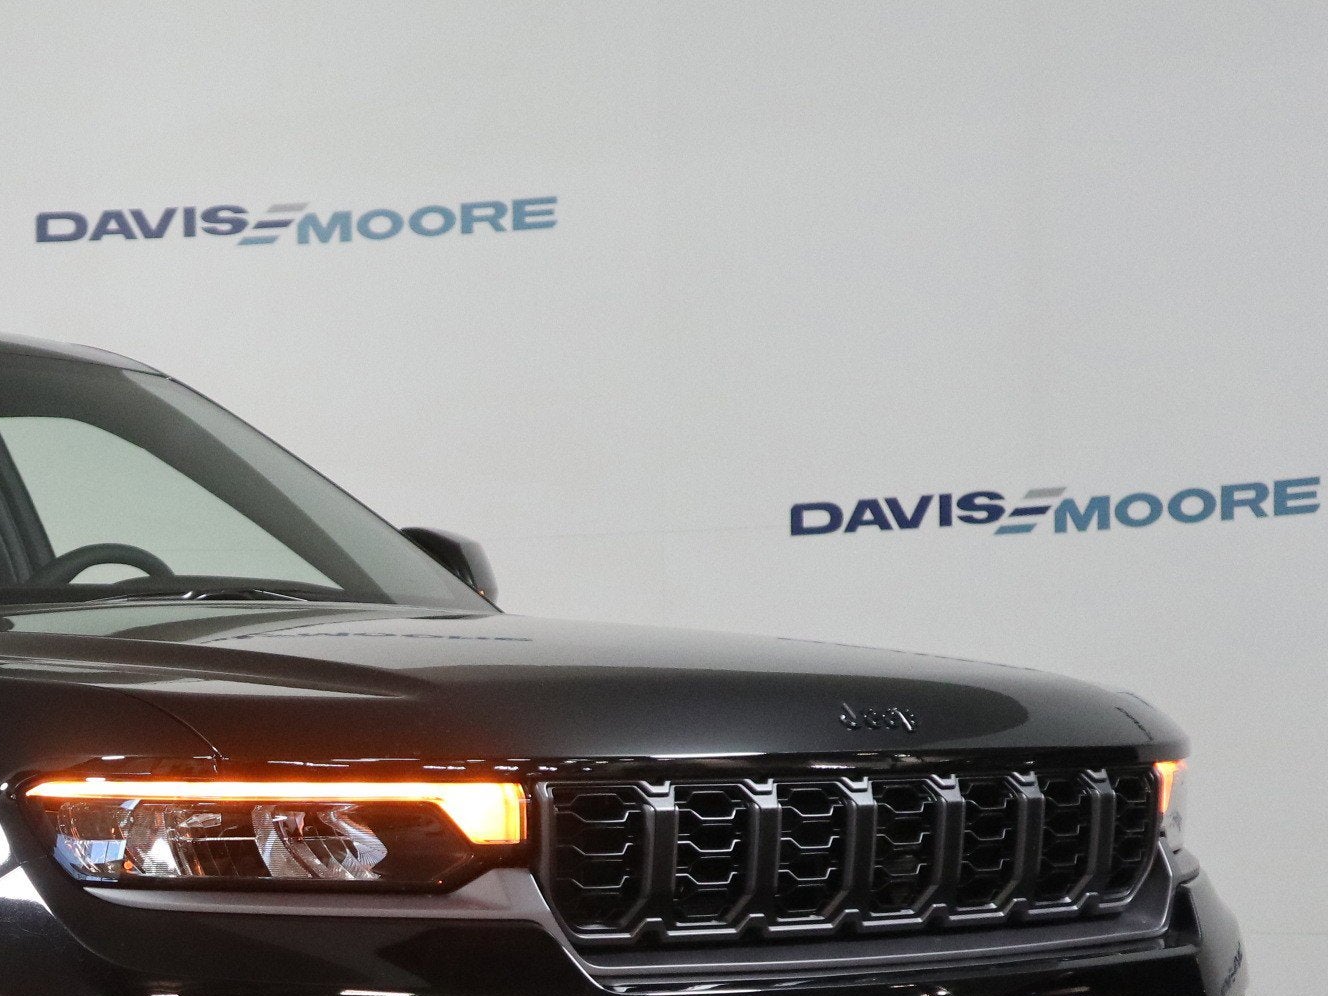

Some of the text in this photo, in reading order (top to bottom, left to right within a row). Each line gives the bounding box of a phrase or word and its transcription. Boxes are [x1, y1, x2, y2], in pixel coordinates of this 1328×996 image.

[35, 196, 558, 245] DAVIS MOORE
[789, 475, 1322, 538] DAVIS MOORE
